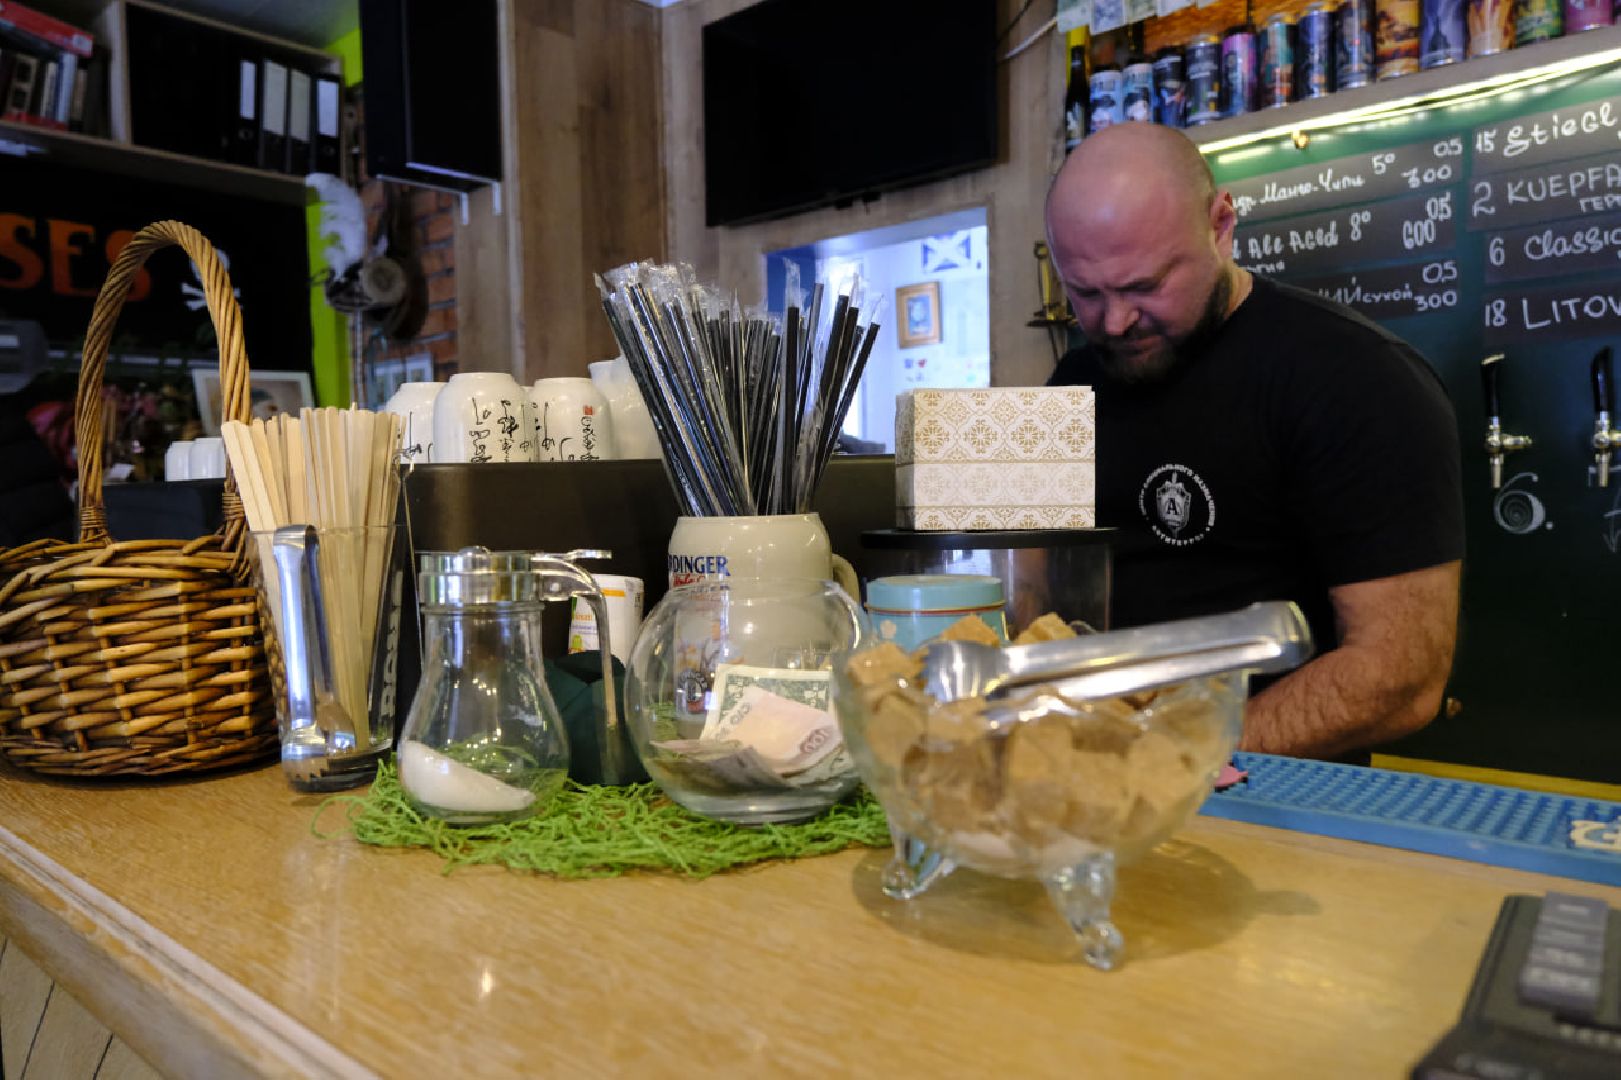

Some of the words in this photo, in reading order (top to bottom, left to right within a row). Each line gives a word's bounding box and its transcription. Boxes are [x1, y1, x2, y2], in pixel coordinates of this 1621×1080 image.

[1476, 130, 1497, 153] 15
[1472, 181, 1496, 217] 2
[1403, 219, 1435, 249] 600
[1489, 237, 1505, 266] 6
[1485, 299, 1507, 327] 18
